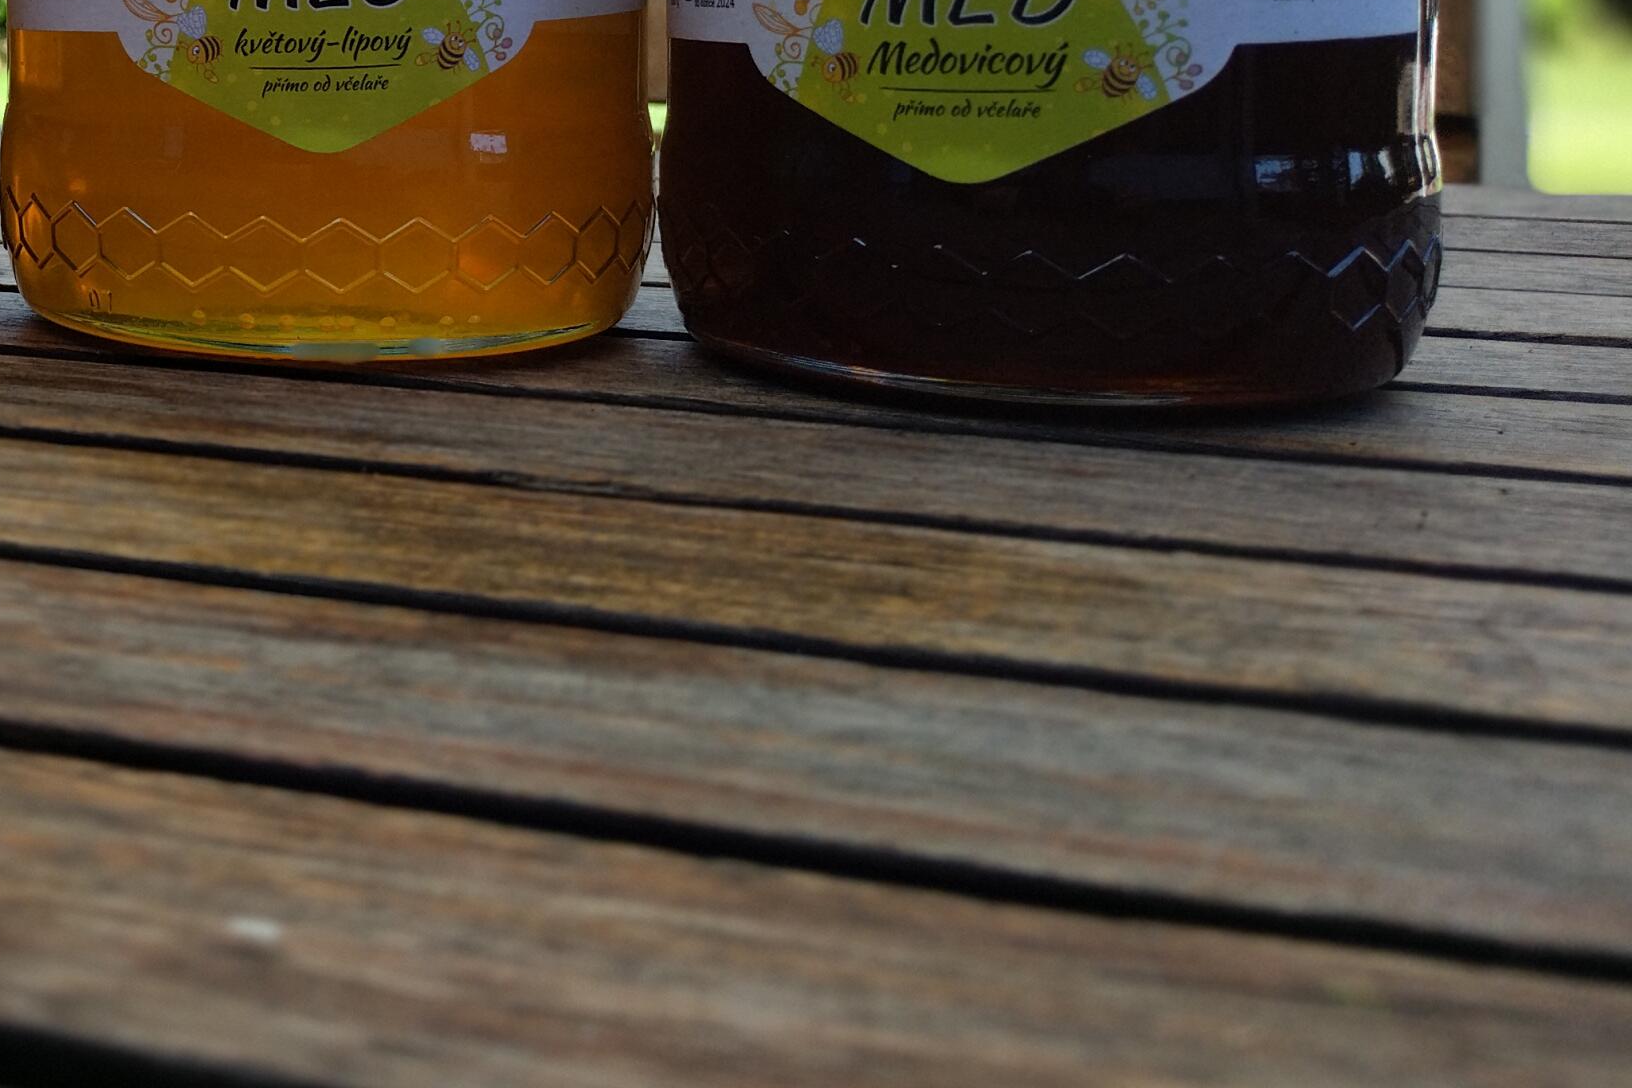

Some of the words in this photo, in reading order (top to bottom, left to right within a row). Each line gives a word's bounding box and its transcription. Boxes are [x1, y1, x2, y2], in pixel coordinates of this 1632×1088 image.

[234, 26, 412, 63] květový-lipový
[866, 37, 1070, 90] Medovicový
[261, 77, 308, 98] přímo
[313, 75, 331, 92] od
[335, 74, 389, 91] včelaře
[892, 99, 945, 121] přímo
[951, 98, 972, 118] od
[977, 99, 1041, 118] včelaře
